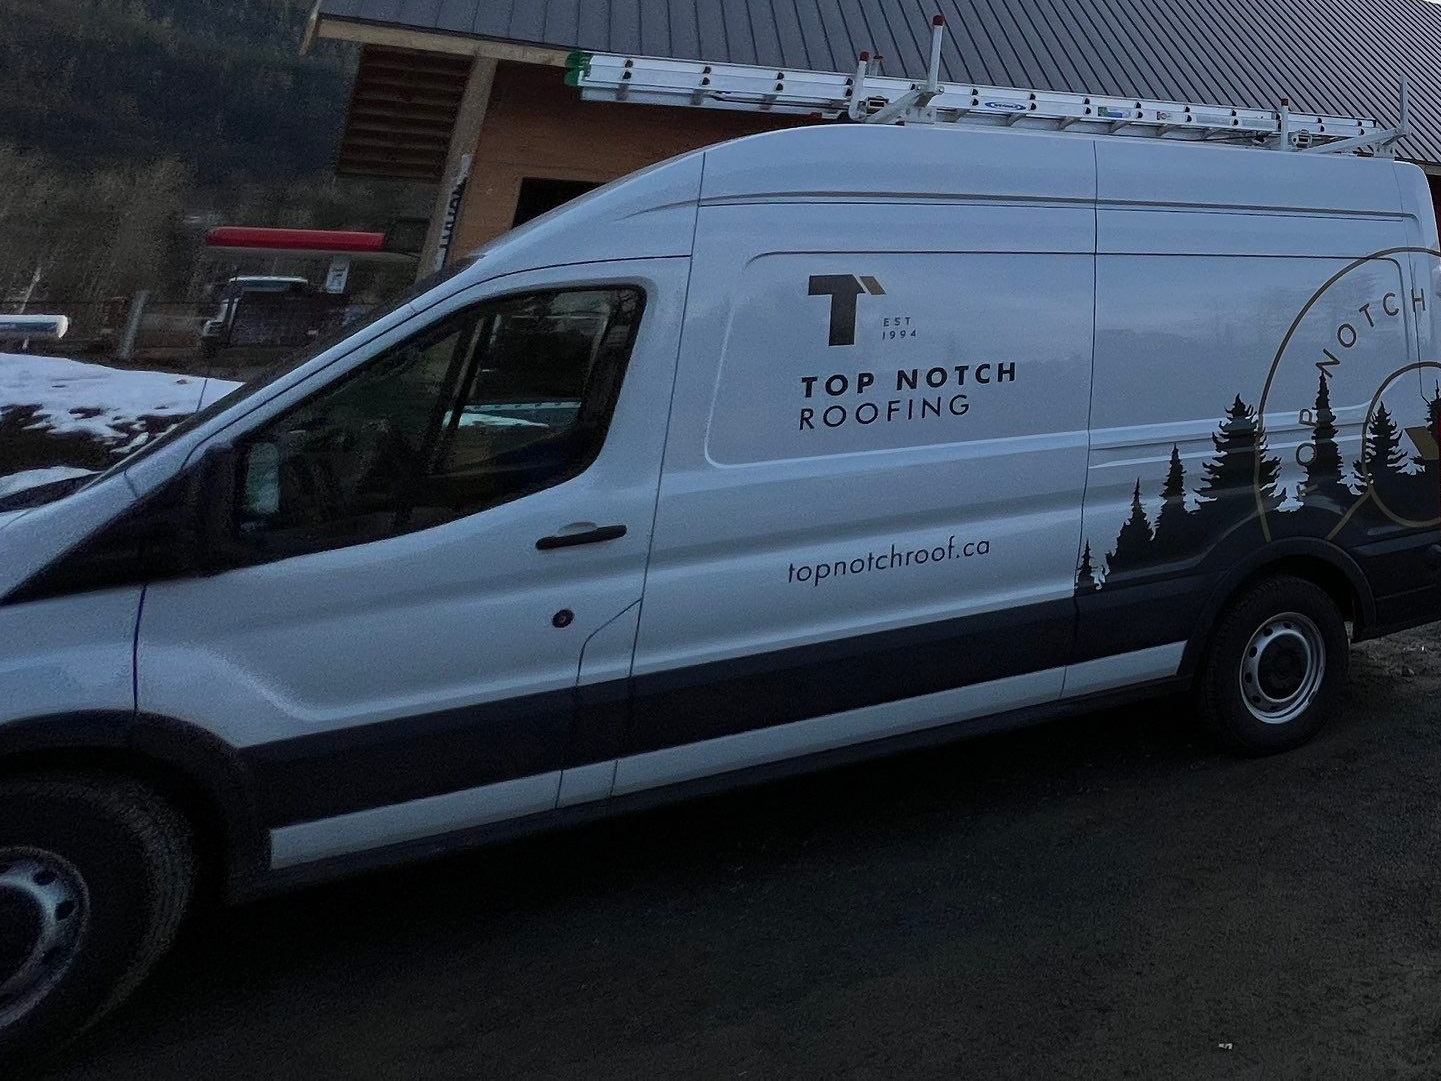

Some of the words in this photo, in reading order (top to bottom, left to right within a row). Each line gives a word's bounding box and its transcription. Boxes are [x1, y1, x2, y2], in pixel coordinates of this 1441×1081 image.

[882, 329, 917, 340] 1994
[883, 316, 911, 327] EST
[1315, 287, 1426, 379] NOTCH
[801, 374, 875, 398] TOP
[896, 362, 1016, 391] NOTCH
[799, 394, 970, 430] ROOFING
[788, 535, 990, 586] topnotchroof.ca
